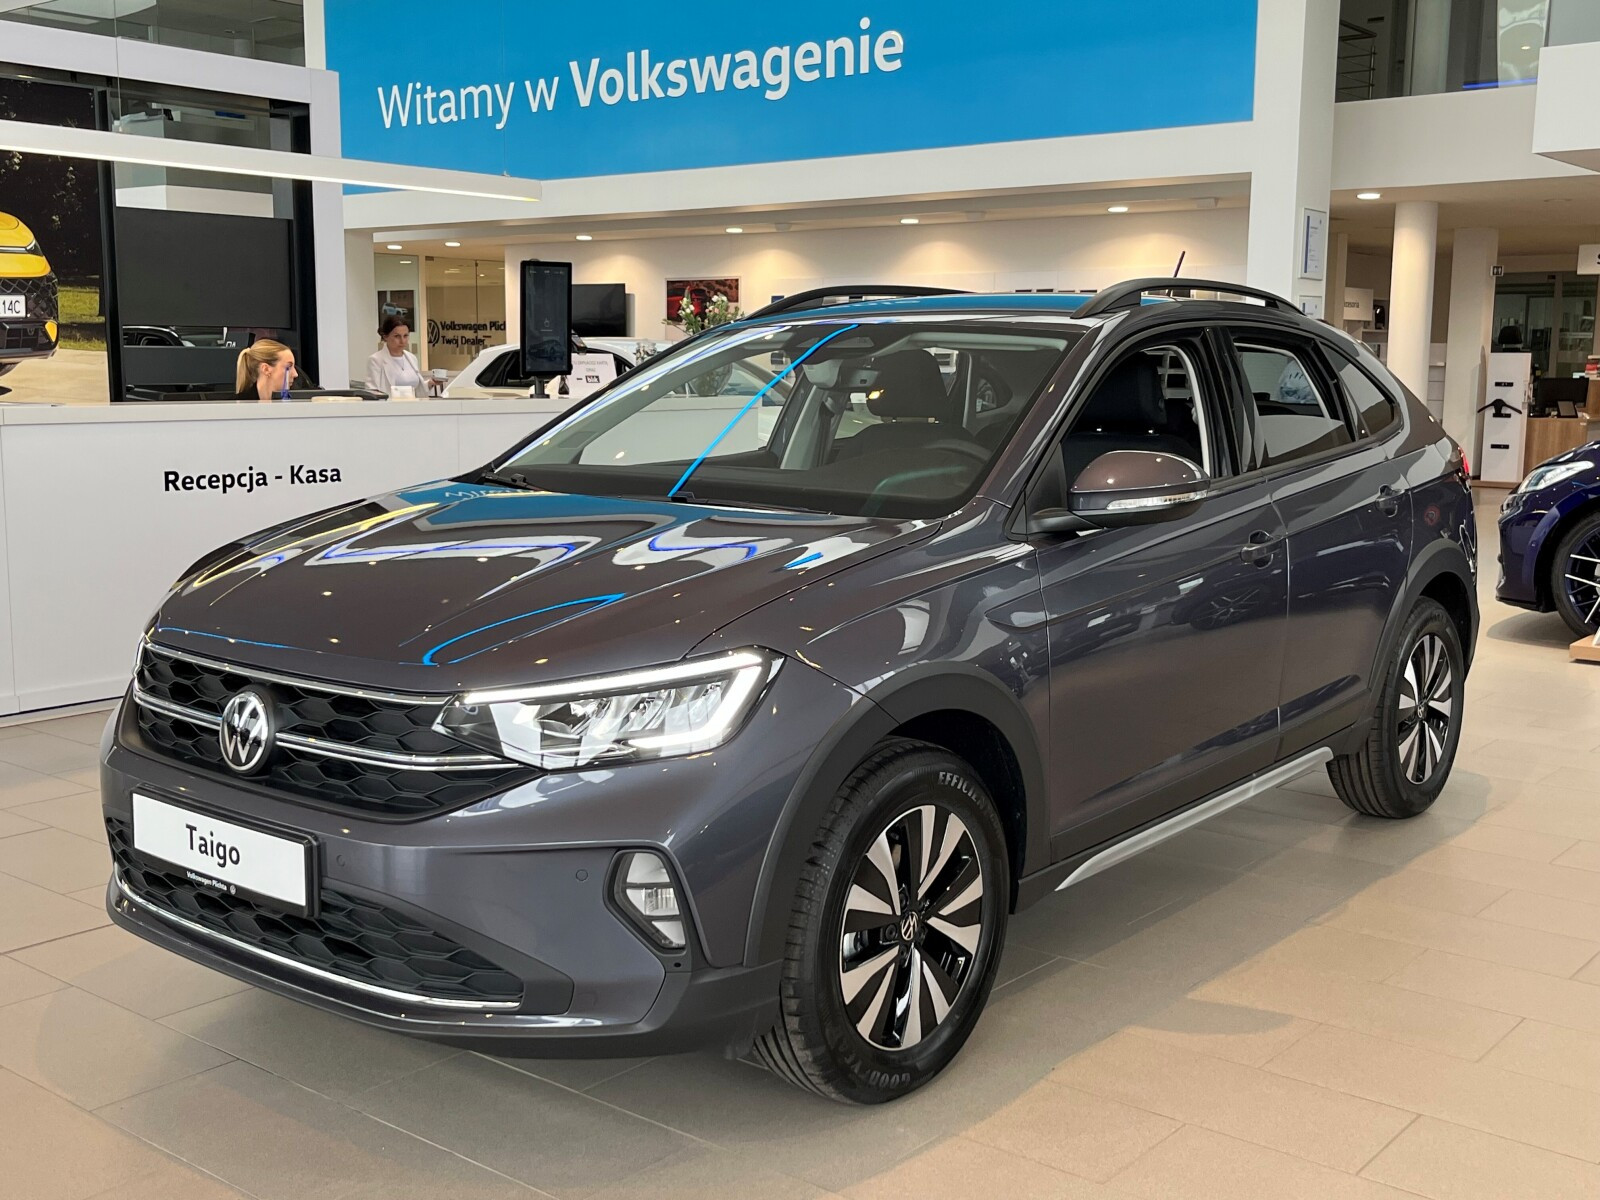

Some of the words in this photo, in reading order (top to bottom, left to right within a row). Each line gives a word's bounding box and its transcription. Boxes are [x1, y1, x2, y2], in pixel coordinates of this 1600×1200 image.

[377, 82, 515, 130] Witamy
[524, 76, 560, 113] w
[568, 17, 904, 108] Volkswagenie
[440, 321, 487, 333] Volkswagen
[441, 335, 459, 348] Twój
[461, 335, 486, 346] Dealer
[164, 466, 268, 494] Recepcja
[290, 464, 342, 485] Kasa
[185, 823, 241, 868] Taigo
[186, 870, 212, 886] Volkswagen
